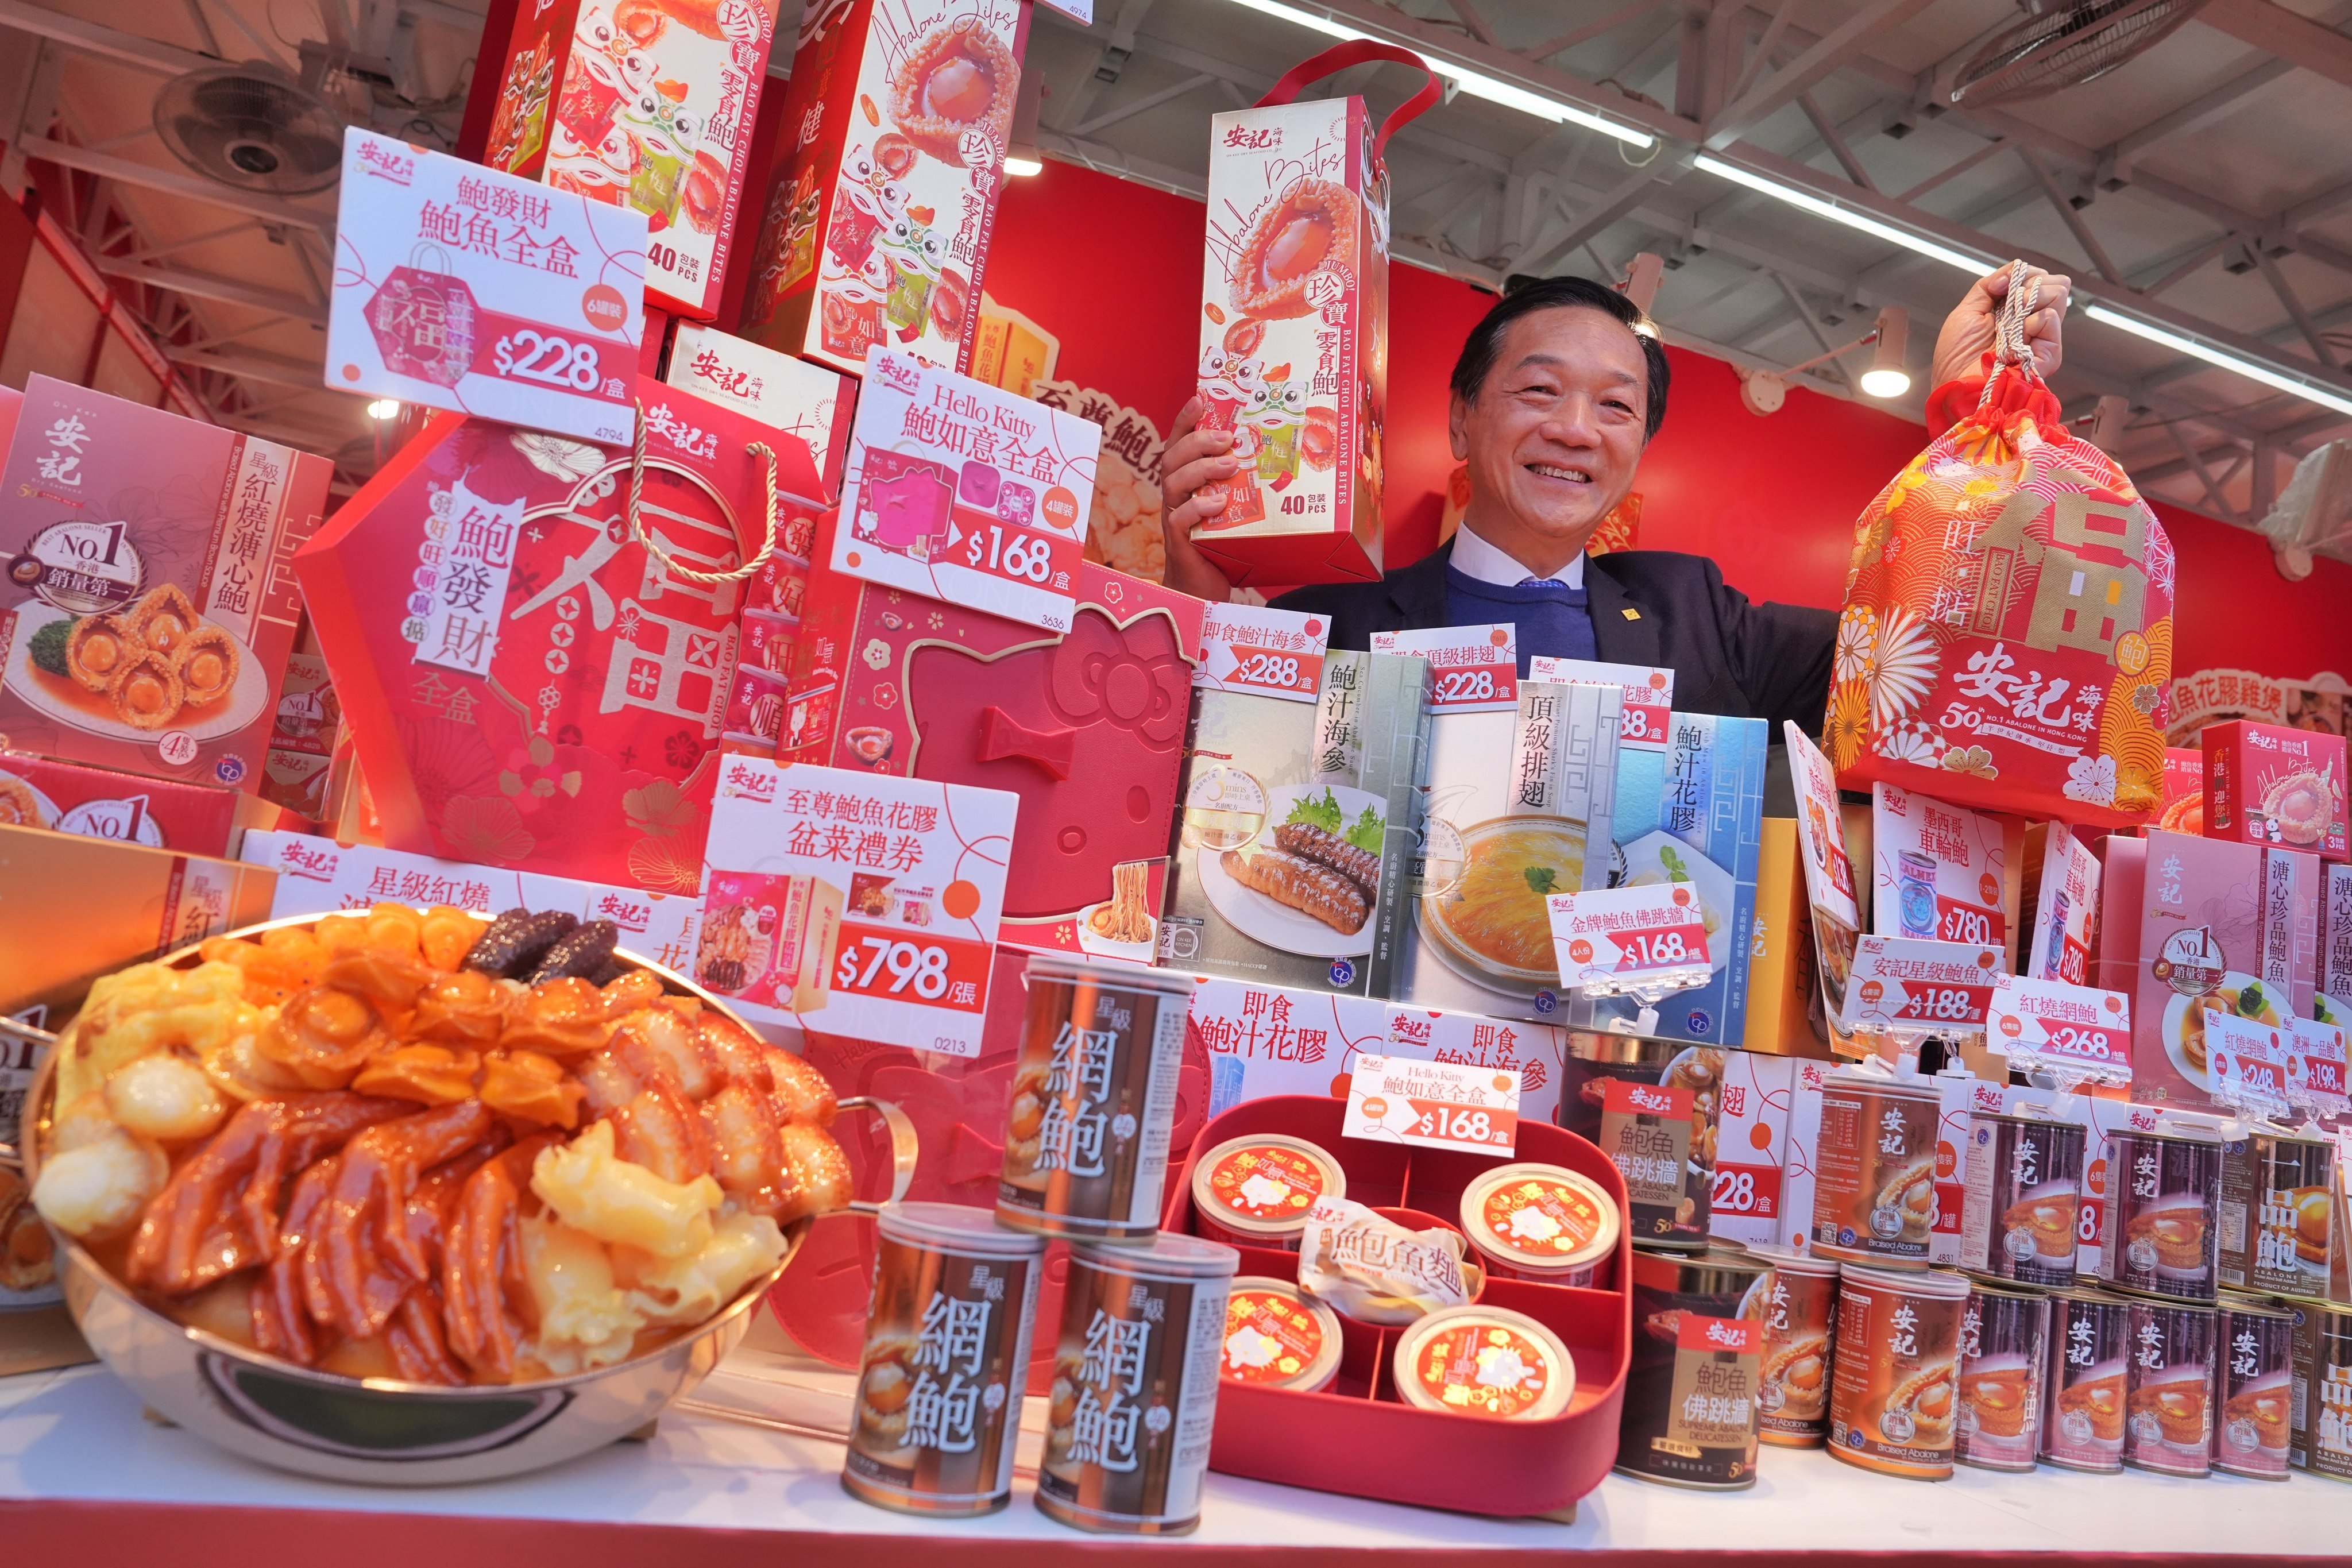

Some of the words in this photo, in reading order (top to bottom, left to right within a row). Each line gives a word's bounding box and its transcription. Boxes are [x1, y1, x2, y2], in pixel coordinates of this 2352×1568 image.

[1069, 6, 1087, 19] 4974
[748, 82, 759, 107] BAO
[741, 114, 753, 137] FAT
[1273, 127, 1283, 146] 海味
[733, 141, 748, 174] CHOI
[979, 121, 1005, 167] JUMBO!
[456, 176, 552, 229] 鮑發財
[720, 177, 738, 239] ABALONE
[986, 203, 995, 226] BAO
[1204, 194, 1275, 284] Abalone
[1265, 138, 1345, 203] Bites
[418, 200, 581, 279] 鮑魚全盒
[980, 233, 989, 253] FAT
[648, 242, 676, 272] 40
[679, 253, 700, 270] 包裝
[710, 244, 723, 283] BITES
[975, 257, 987, 286] CHOI
[678, 267, 698, 282] PCS
[1323, 260, 1355, 291] JUMBO!
[963, 288, 979, 340] ABALONE
[1343, 329, 1351, 349] BAO
[690, 350, 749, 397] 安記
[750, 377, 764, 401] 海味
[1311, 331, 1338, 397] 零食鮑
[1342, 356, 1350, 374] FAT
[719, 393, 740, 404] SEAFOOD
[1341, 377, 1350, 407] CHOI
[933, 384, 989, 423] Hello
[991, 405, 1037, 443] Kitty
[594, 427, 623, 442] 4794
[646, 403, 703, 456] 安記
[704, 433, 719, 459] 海味
[901, 401, 1060, 485] 鮑如意全盒
[1339, 414, 1349, 468] ABALONE
[36, 415, 91, 486] 安記
[1338, 469, 1347, 505] BITES
[1045, 500, 1074, 517] 4罐裝
[1281, 496, 1304, 515] 40
[1308, 494, 1326, 503] 包裝
[1308, 505, 1326, 513] PCS
[214, 473, 276, 615] 紅燒溏心鮑
[1942, 519, 1986, 556] 旺
[75, 561, 100, 574] 香港
[1994, 554, 2005, 575] BAO
[47, 568, 130, 597] 銷量第一
[437, 505, 514, 669] 鮑發財
[1989, 578, 2000, 598] FAT
[1041, 615, 1064, 629] 3636
[1929, 585, 1972, 627] 掂
[1982, 601, 1995, 629] CHOI
[724, 635, 736, 662] BAO
[1203, 621, 1307, 650] 即食鮑汁海參
[1374, 635, 1391, 645] 安記
[2118, 637, 2145, 671] 鮑
[719, 666, 730, 692] FAT
[1954, 642, 2071, 729] 安記
[2071, 685, 2104, 733] 海味
[411, 671, 480, 725] 全盒
[711, 696, 724, 729] CHOI
[1320, 663, 1358, 773] 鮑汁海參
[1986, 715, 2003, 723] NO.1
[2005, 719, 2037, 731] ABALONE
[2046, 728, 2065, 737] HONG
[2067, 733, 2088, 743] KONG
[164, 736, 180, 756] 4
[1517, 696, 1555, 808] 頂級排翅
[1226, 783, 1246, 793] mins
[1670, 725, 1702, 832] 鮑汁花膠
[783, 788, 938, 833] 至尊鮑魚花膠
[1923, 806, 1963, 837] 墨西哥
[785, 820, 924, 874] 盆菜禮券
[1918, 828, 1969, 867] 車輪鮑
[2328, 836, 2335, 848] 3
[366, 865, 491, 912] 星級紅燒
[2157, 853, 2184, 905] 安記
[1570, 906, 1685, 934] 金牌鮑魚佛跳牆
[2267, 860, 2290, 983] 溏心珍品鮑魚
[1571, 946, 1590, 957] 4人份
[1871, 957, 1980, 984] 安記星級鮑魚
[2173, 965, 2219, 982] 銷量第一
[1243, 989, 1295, 1024] 即食
[2019, 994, 2098, 1024] 紅燒網鮑
[934, 1037, 966, 1054] 0213
[1198, 1014, 1328, 1064] 鮑汁花膠
[1472, 1023, 1519, 1055] 即食
[2224, 1030, 2268, 1060] 紅燒網鮑
[1408, 1066, 1438, 1080] Hello
[1440, 1070, 1465, 1083] Kitty
[1032, 1020, 1119, 1179] 網鮑
[1381, 1077, 1487, 1105] 鮑如意全盒
[1618, 1123, 1676, 1161] 鮑魚
[1879, 1107, 1907, 1156] 安記
[1611, 1152, 1678, 1185] 佛跳牆
[2010, 1139, 2040, 1185] 安記
[2132, 1153, 2160, 1198] 安記
[2256, 1157, 2301, 1273] 一品鮑
[1868, 1237, 1895, 1250] Braised
[1896, 1240, 1923, 1252] Abalone
[1937, 1253, 1954, 1264] 4831
[2254, 1269, 2297, 1280] ABALONE
[1887, 1305, 1920, 1355] 安記
[2065, 1317, 2096, 1367] 安記
[2135, 1322, 2165, 1370] 安記
[2230, 1330, 2260, 1377] 安記
[898, 1290, 992, 1454] 網鮑
[1695, 1361, 1747, 1399] 鮑魚
[1067, 1308, 1153, 1474] 網鮑
[1678, 1419, 1716, 1431] SUPREME
[1682, 1395, 1749, 1424] 佛跳牆
[1778, 1419, 1809, 1428] Abalone
[1878, 1443, 1909, 1456] Braised
[1909, 1449, 1939, 1459] Abalone
